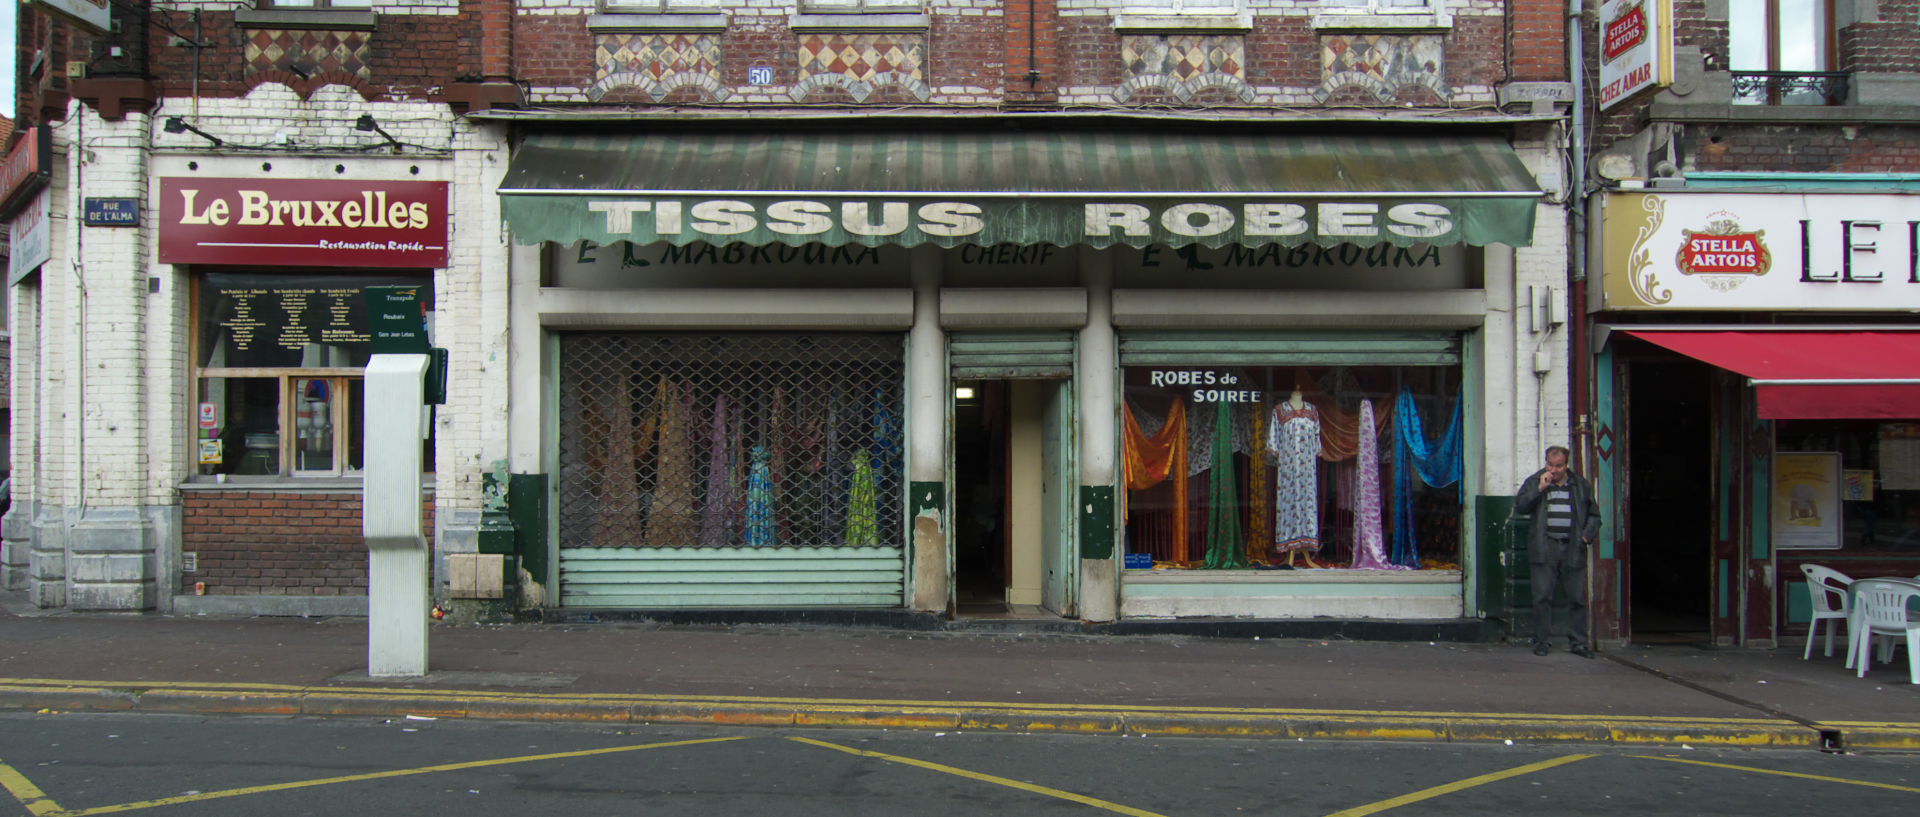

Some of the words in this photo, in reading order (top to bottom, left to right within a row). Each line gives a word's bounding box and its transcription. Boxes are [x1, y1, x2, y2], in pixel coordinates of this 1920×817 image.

[1609, 14, 1638, 40] STELLA
[1610, 26, 1640, 52] ARTOIS
[751, 69, 770, 85] 50
[1600, 78, 1621, 104] CHEZ
[1622, 62, 1651, 93] AMAR
[103, 202, 119, 210] RUE
[179, 189, 229, 226] Le
[237, 190, 429, 229] Bruxelles
[90, 212, 101, 220] DE
[104, 212, 133, 220] L'ALMA
[588, 200, 984, 236] TISSUS
[1085, 203, 1453, 236] ROBES
[319, 239, 386, 251] Restauration
[387, 240, 424, 253] Rapide
[1691, 239, 1755, 252] STELLA
[1799, 220, 1883, 283] LE
[1691, 254, 1757, 267] ARTOIS
[1151, 371, 1216, 387] ROBES
[1220, 373, 1238, 384] de
[1193, 390, 1261, 402] SOIREE
